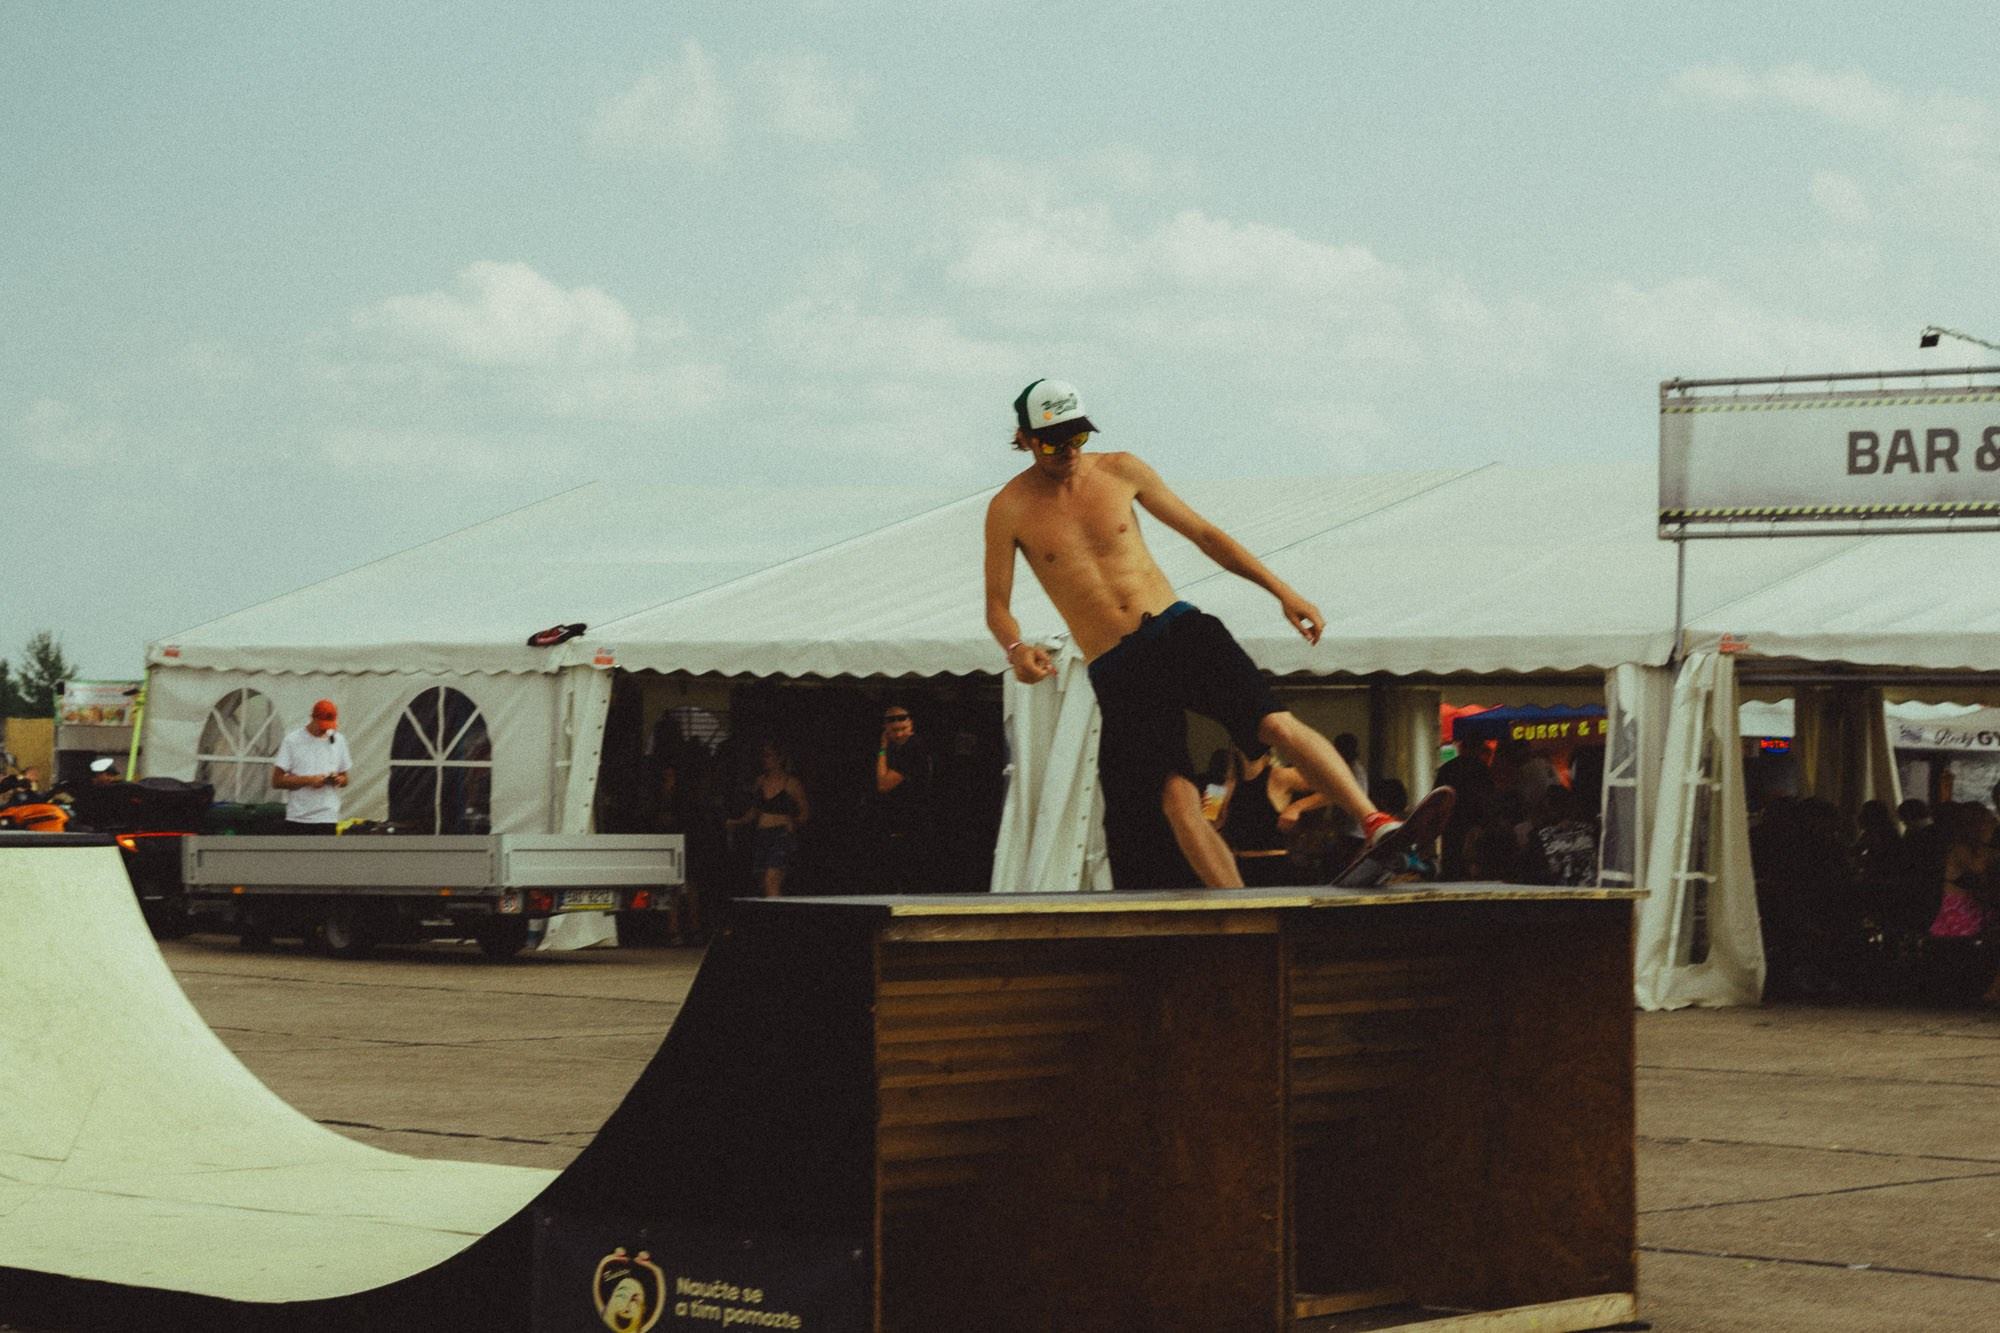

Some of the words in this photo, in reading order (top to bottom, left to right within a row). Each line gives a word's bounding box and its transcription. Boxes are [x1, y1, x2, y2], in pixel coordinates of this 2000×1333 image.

[1847, 428, 1960, 476] BAR
[1975, 425, 2000, 472] &
[1512, 723, 1570, 740] CURRY
[1578, 721, 1589, 736] &
[742, 1288, 764, 1303] se
[675, 1302, 688, 1317] a
[722, 1307, 802, 1330] pomozte
